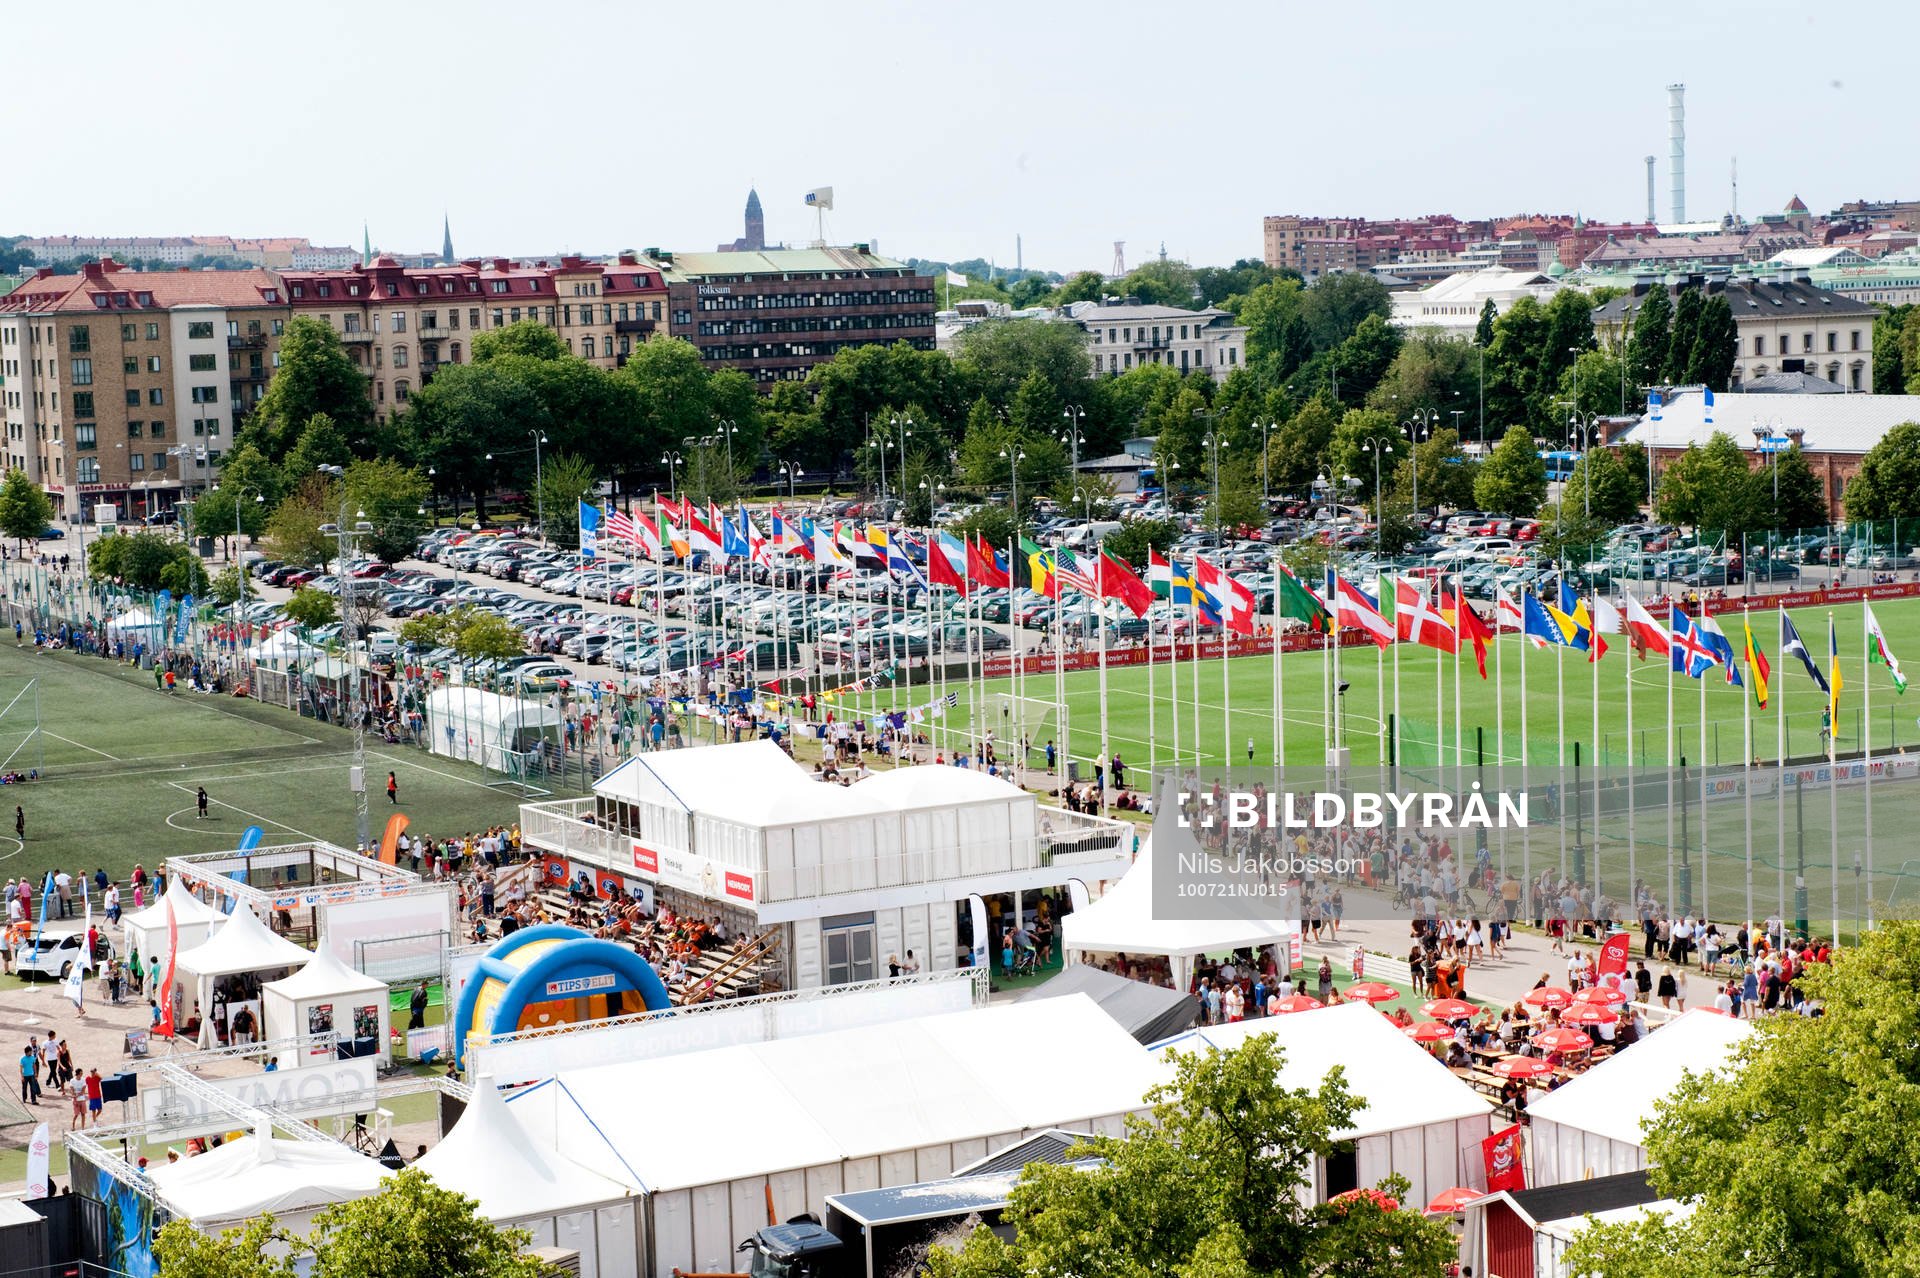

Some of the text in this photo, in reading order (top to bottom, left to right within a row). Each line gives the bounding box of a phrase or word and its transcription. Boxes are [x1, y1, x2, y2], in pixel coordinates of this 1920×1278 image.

[698, 285, 731, 295] Folksam
[1828, 591, 1859, 599] McDonald's
[1873, 587, 1904, 596] McDonald's
[1205, 644, 1241, 653] McDoald's
[1706, 780, 1735, 795] ELON
[558, 976, 614, 992] TIPS ELIT
